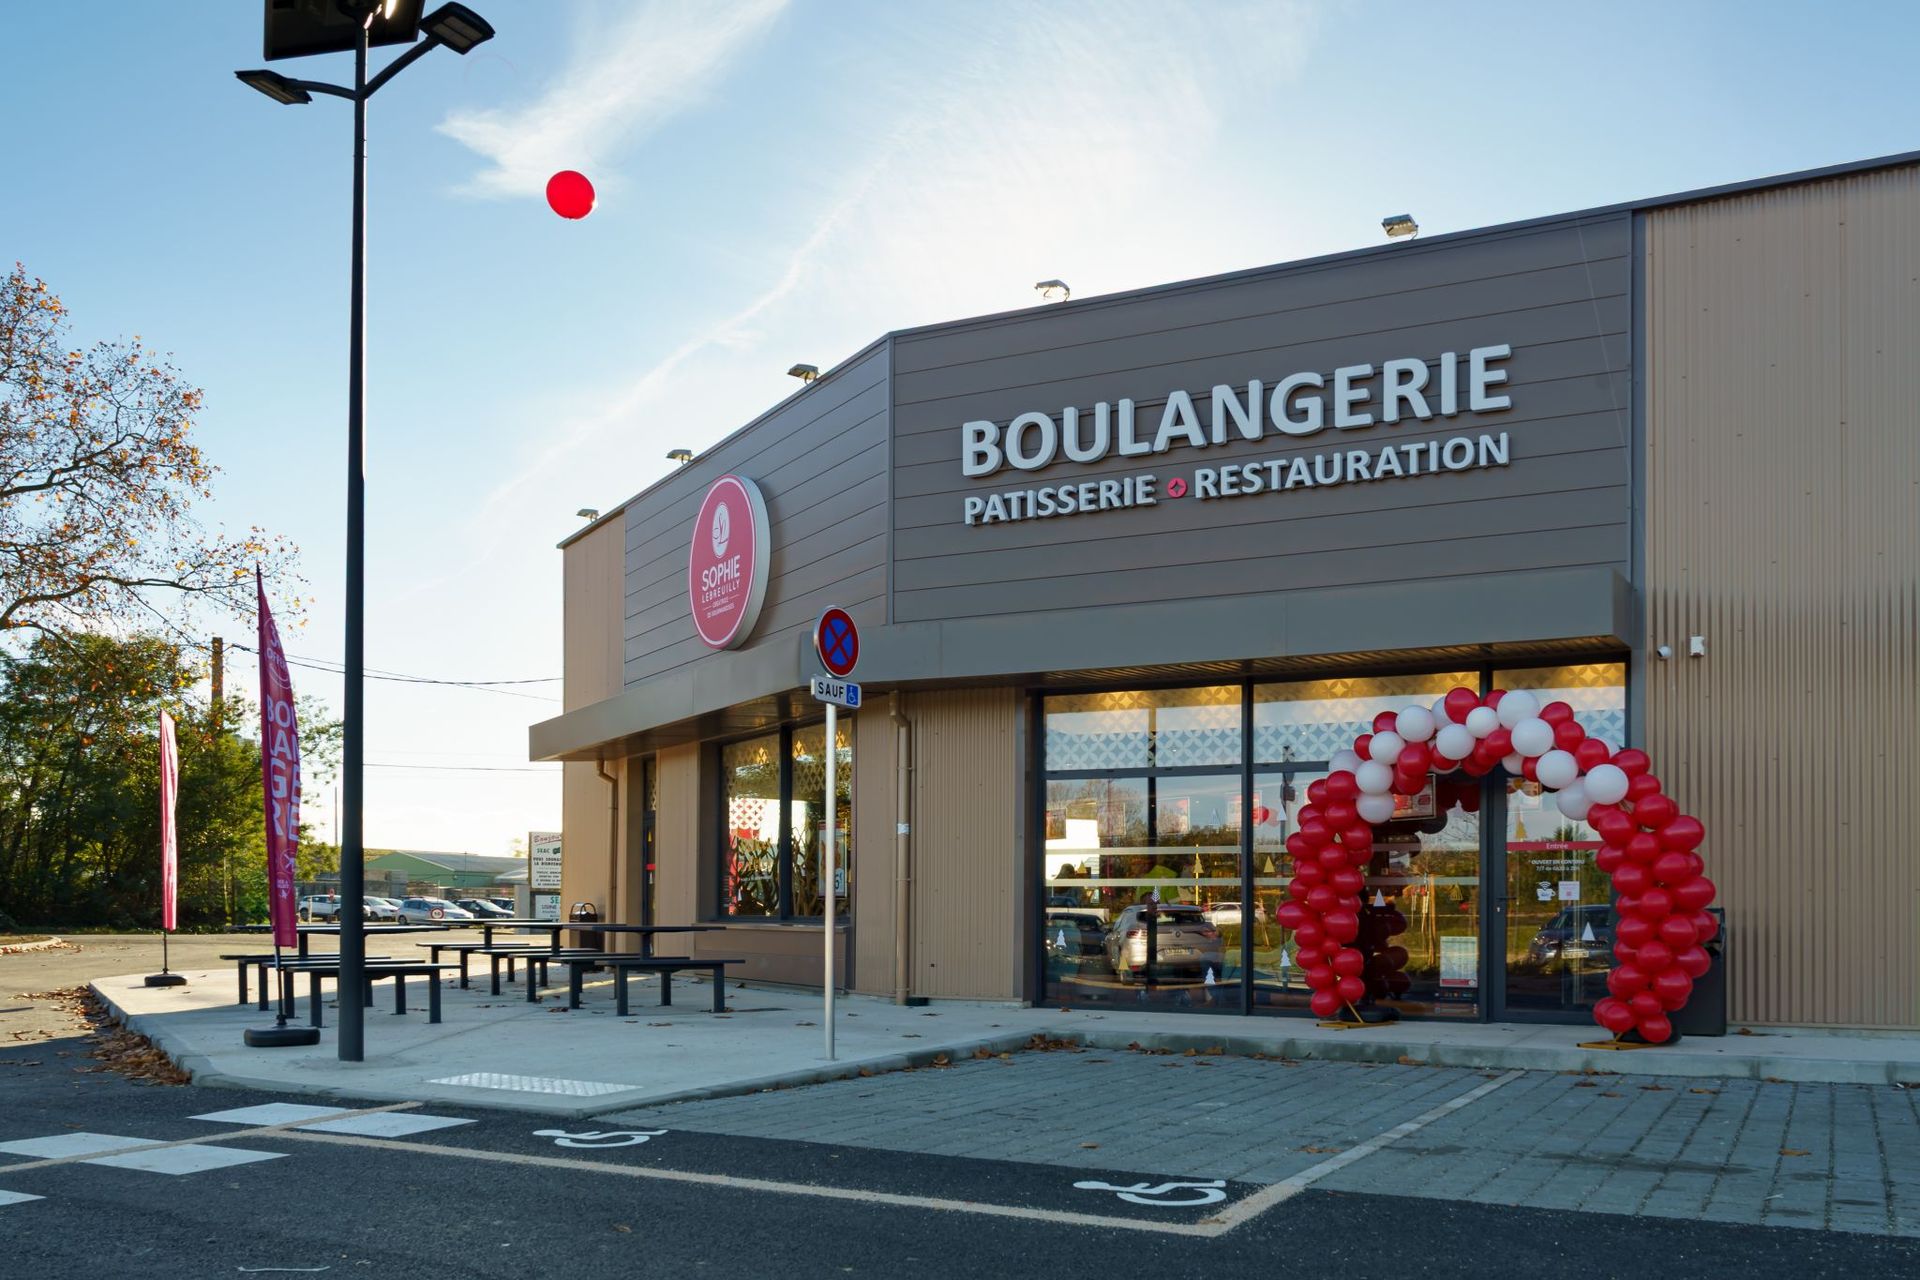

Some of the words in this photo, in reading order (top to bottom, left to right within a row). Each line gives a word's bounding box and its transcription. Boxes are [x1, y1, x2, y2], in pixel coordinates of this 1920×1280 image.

[962, 343, 1512, 478] BOULANGERIE
[964, 474, 1157, 526] PATISSERIE
[1194, 432, 1510, 499] RESTAURATION
[702, 555, 740, 591] SOPHIE
[702, 580, 740, 603] LEBREUILLY
[818, 682, 844, 698] SAUF
